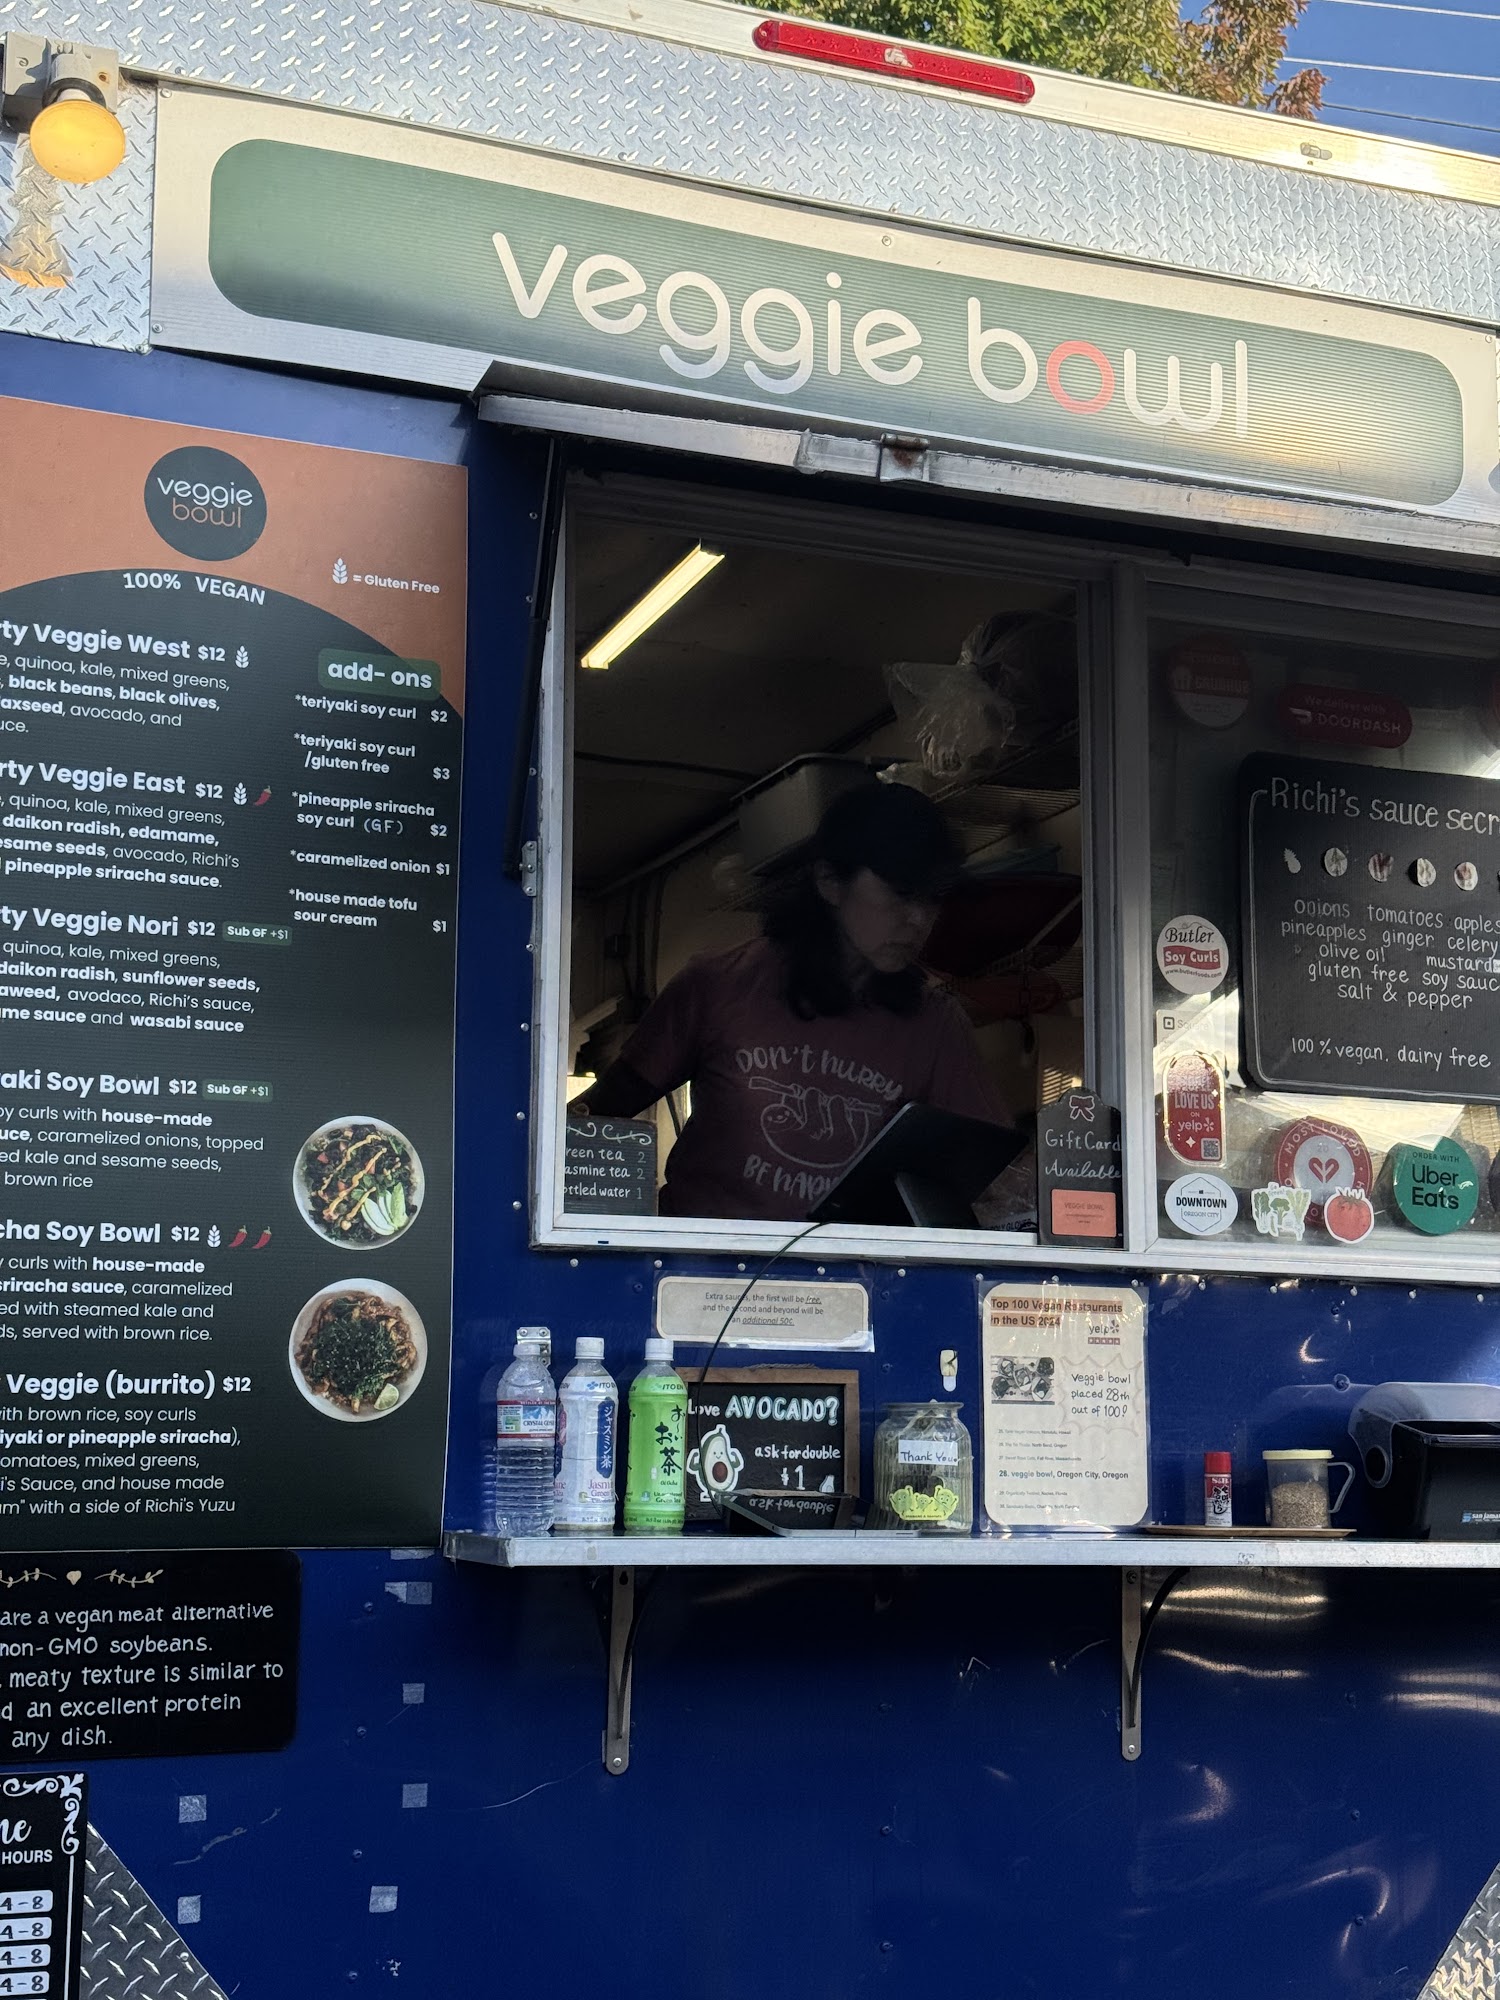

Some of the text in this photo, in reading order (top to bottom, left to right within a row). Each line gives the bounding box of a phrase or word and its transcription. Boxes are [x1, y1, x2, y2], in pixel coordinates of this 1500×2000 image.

[491, 231, 1248, 439] veggie bowl
[157, 477, 253, 509] veggie
[172, 497, 242, 528] bowl
[122, 572, 266, 605] 100% VEGAN
[364, 574, 440, 594] Gluten Free
[33, 623, 226, 663] Veggie West $12
[14, 657, 230, 692] quinoa, kale, mixed greens,
[360, 703, 386, 719] soy
[388, 704, 417, 720] curl
[430, 708, 448, 723] $2
[38, 762, 129, 792] Veggie
[133, 771, 186, 795] East
[195, 783, 224, 799] $12
[1271, 777, 1361, 817] Richi's
[1370, 798, 1439, 828] sauce
[2, 814, 220, 847] daikon radish, edamame,
[390, 858, 431, 875] onion
[435, 861, 450, 876] $1
[343, 891, 385, 909] made
[388, 894, 418, 912] tofu
[32, 907, 289, 941] Veggie Nori $12 Sub GF +$1
[294, 910, 448, 933] sour cream $1
[1367, 904, 1443, 928] tomatoes
[1164, 925, 1215, 944] Butler
[1281, 920, 1498, 958] pineapples ginger celery
[1165, 950, 1219, 964] Soy Curls
[1319, 942, 1493, 973] olive oil mustard
[67, 987, 255, 1014] avodaco, Richi's sauce,
[1337, 982, 1473, 1012] salt & pepper
[1397, 1047, 1443, 1072] dairy
[1449, 1047, 1491, 1068] free
[46, 1071, 197, 1098] Soy Bowl $12
[1174, 1091, 1215, 1110] LOVE US
[1178, 1119, 1203, 1133] yelp
[37, 1127, 264, 1153] caramelized onions, topped
[1045, 1128, 1082, 1150] Gift
[599, 1148, 646, 1163] tea 2
[1412, 1151, 1460, 1163] ORDER WITH
[609, 1165, 630, 1178] tea
[637, 1167, 645, 1180] 2
[1045, 1158, 1121, 1179] Available
[1411, 1163, 1459, 1187] Uber
[599, 1186, 643, 1199] water 1
[1176, 1196, 1227, 1209] DOWNTOWN
[1411, 1187, 1459, 1210] Eats
[991, 1299, 1009, 1310] Top
[1012, 1300, 1029, 1310] 100
[1002, 1315, 1018, 1326] the
[1021, 1316, 1035, 1326] US
[1089, 1323, 1110, 1336] yelp
[6, 1369, 252, 1401] Veggie (burrito) $12
[1071, 1372, 1131, 1387] veggie bowl
[1071, 1388, 1130, 1401] placed 28th
[725, 1394, 839, 1426] AVOCADO?
[602, 1405, 614, 1469] ジャスミン茶
[655, 1422, 682, 1476] お茶
[755, 1444, 841, 1459] ask for double
[901, 1450, 932, 1462] Thank
[1011, 1471, 1035, 1480] veggie
[1056, 1471, 1083, 1480] Oregon
[1085, 1470, 1101, 1480] City,
[1102, 1471, 1129, 1481] Oregon
[0, 1603, 274, 1633] are a vegan meat alternative
[110, 1635, 213, 1660] soybeans.
[9, 1661, 284, 1692] meaty texture is similar to
[2, 1849, 53, 1865] HOURS
